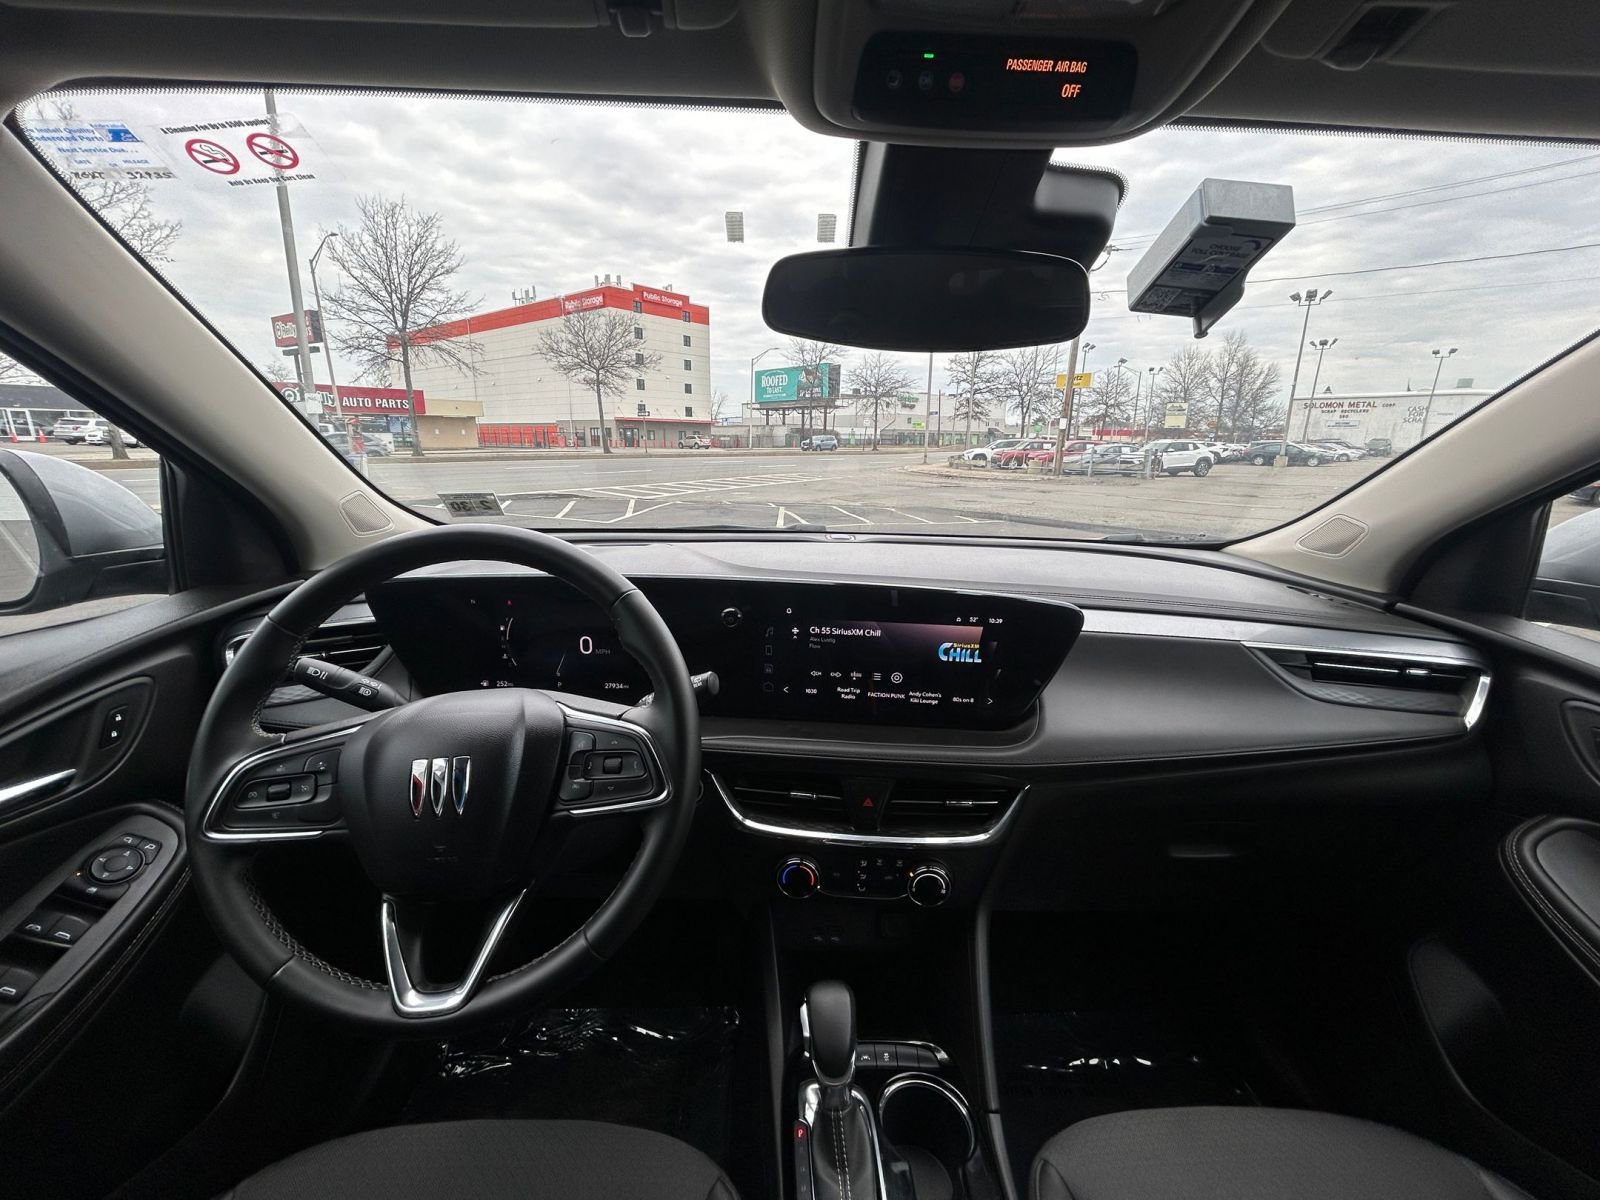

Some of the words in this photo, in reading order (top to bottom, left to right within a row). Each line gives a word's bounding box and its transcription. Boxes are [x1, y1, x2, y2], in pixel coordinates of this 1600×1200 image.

[1006, 58, 1054, 72] PASSENGER
[1054, 61, 1070, 73] AIR
[1070, 61, 1088, 73] BAG
[1061, 83, 1082, 98] OFF
[64, 127, 96, 135] Quality
[167, 125, 199, 134] Cleaning
[252, 177, 269, 185] Keep
[565, 300, 581, 310] Public
[582, 295, 603, 307] Storage
[643, 291, 661, 301] Public
[661, 295, 683, 307] Storage
[761, 374, 788, 388] ROOFED
[342, 397, 372, 408] AUTO
[375, 398, 409, 409] PARTS
[1303, 402, 1344, 410] SOLOMON
[1347, 401, 1378, 409] METAL
[809, 626, 820, 634] Ch
[821, 626, 831, 635] 55
[831, 627, 864, 636] SiriusXM
[864, 629, 882, 637] Chill
[580, 636, 593, 655] 0
[938, 642, 982, 664] CHILL
[908, 690, 922, 698] Andy
